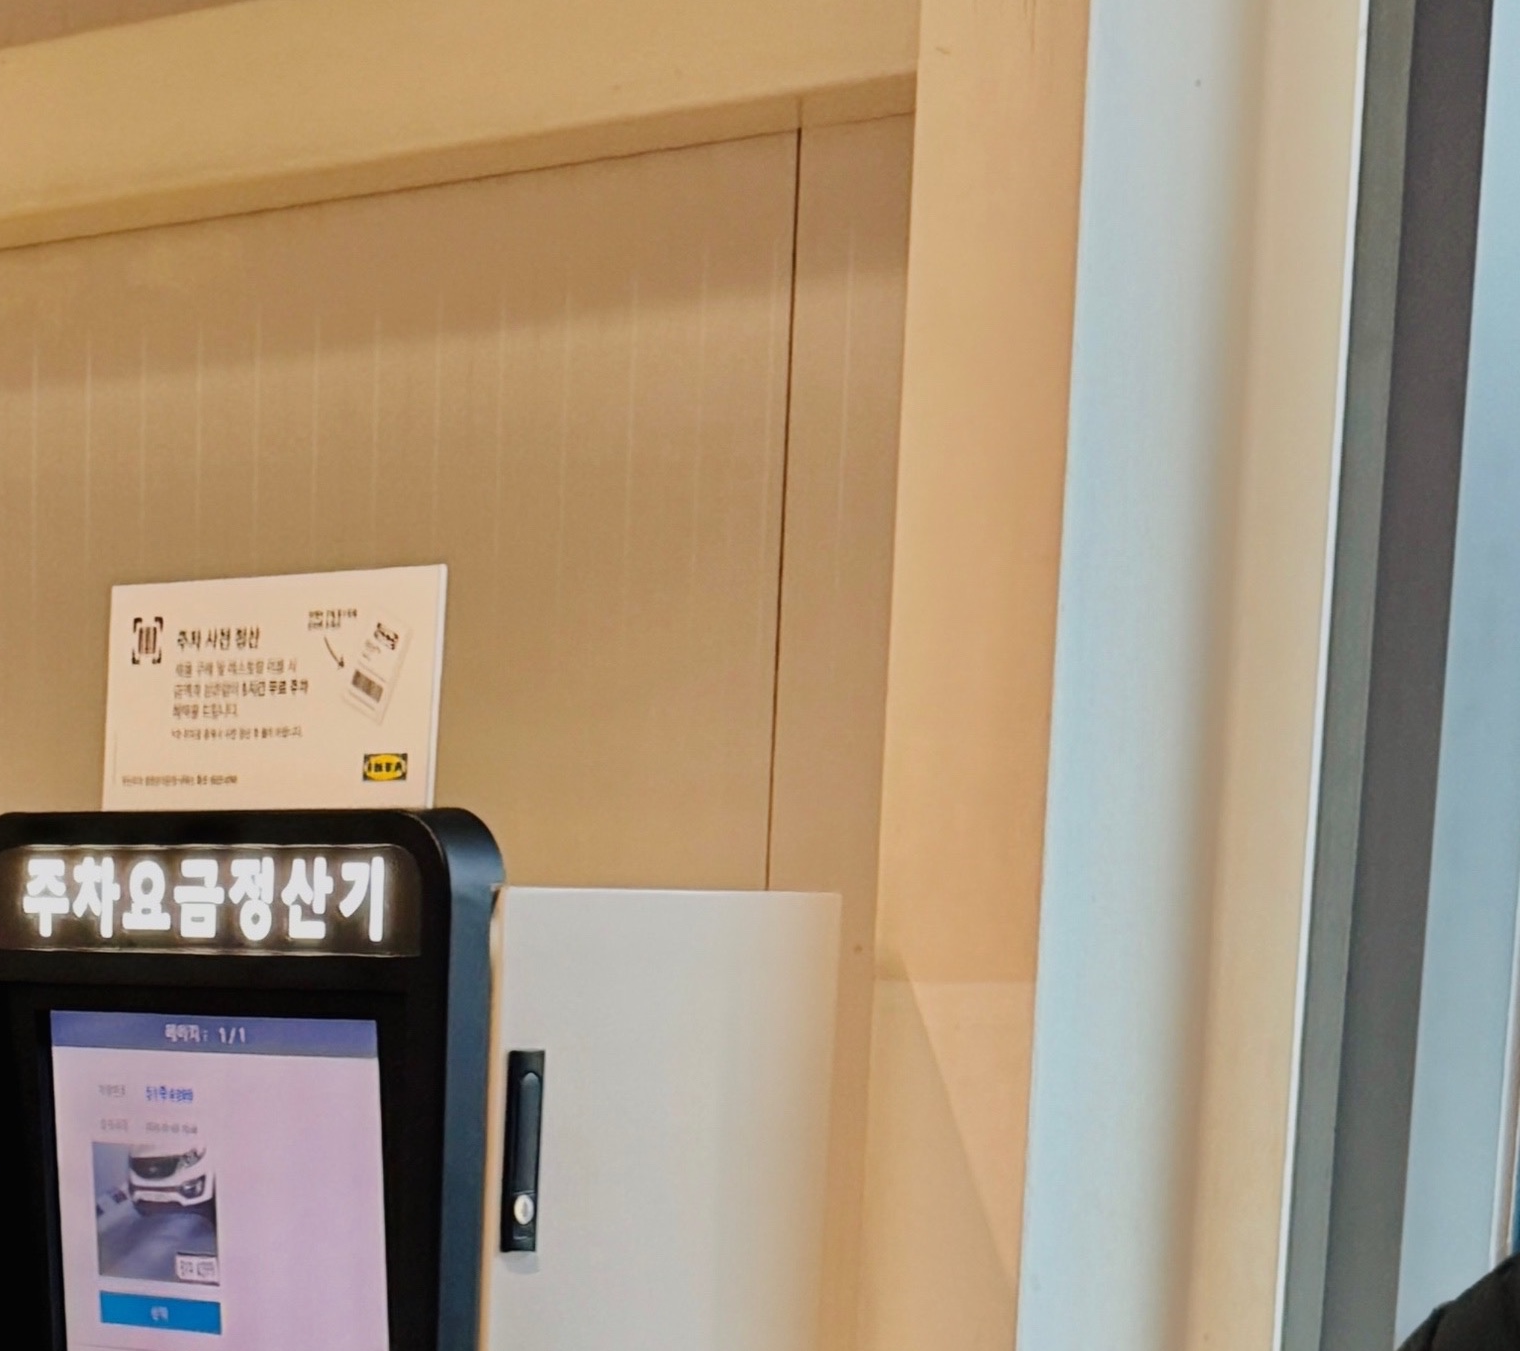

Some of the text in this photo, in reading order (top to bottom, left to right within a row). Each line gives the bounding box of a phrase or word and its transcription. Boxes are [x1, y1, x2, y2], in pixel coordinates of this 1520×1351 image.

[177, 630, 201, 650] 주차
[22, 856, 384, 942] 주차요금정산기
[219, 1027, 246, 1044] 1/1
